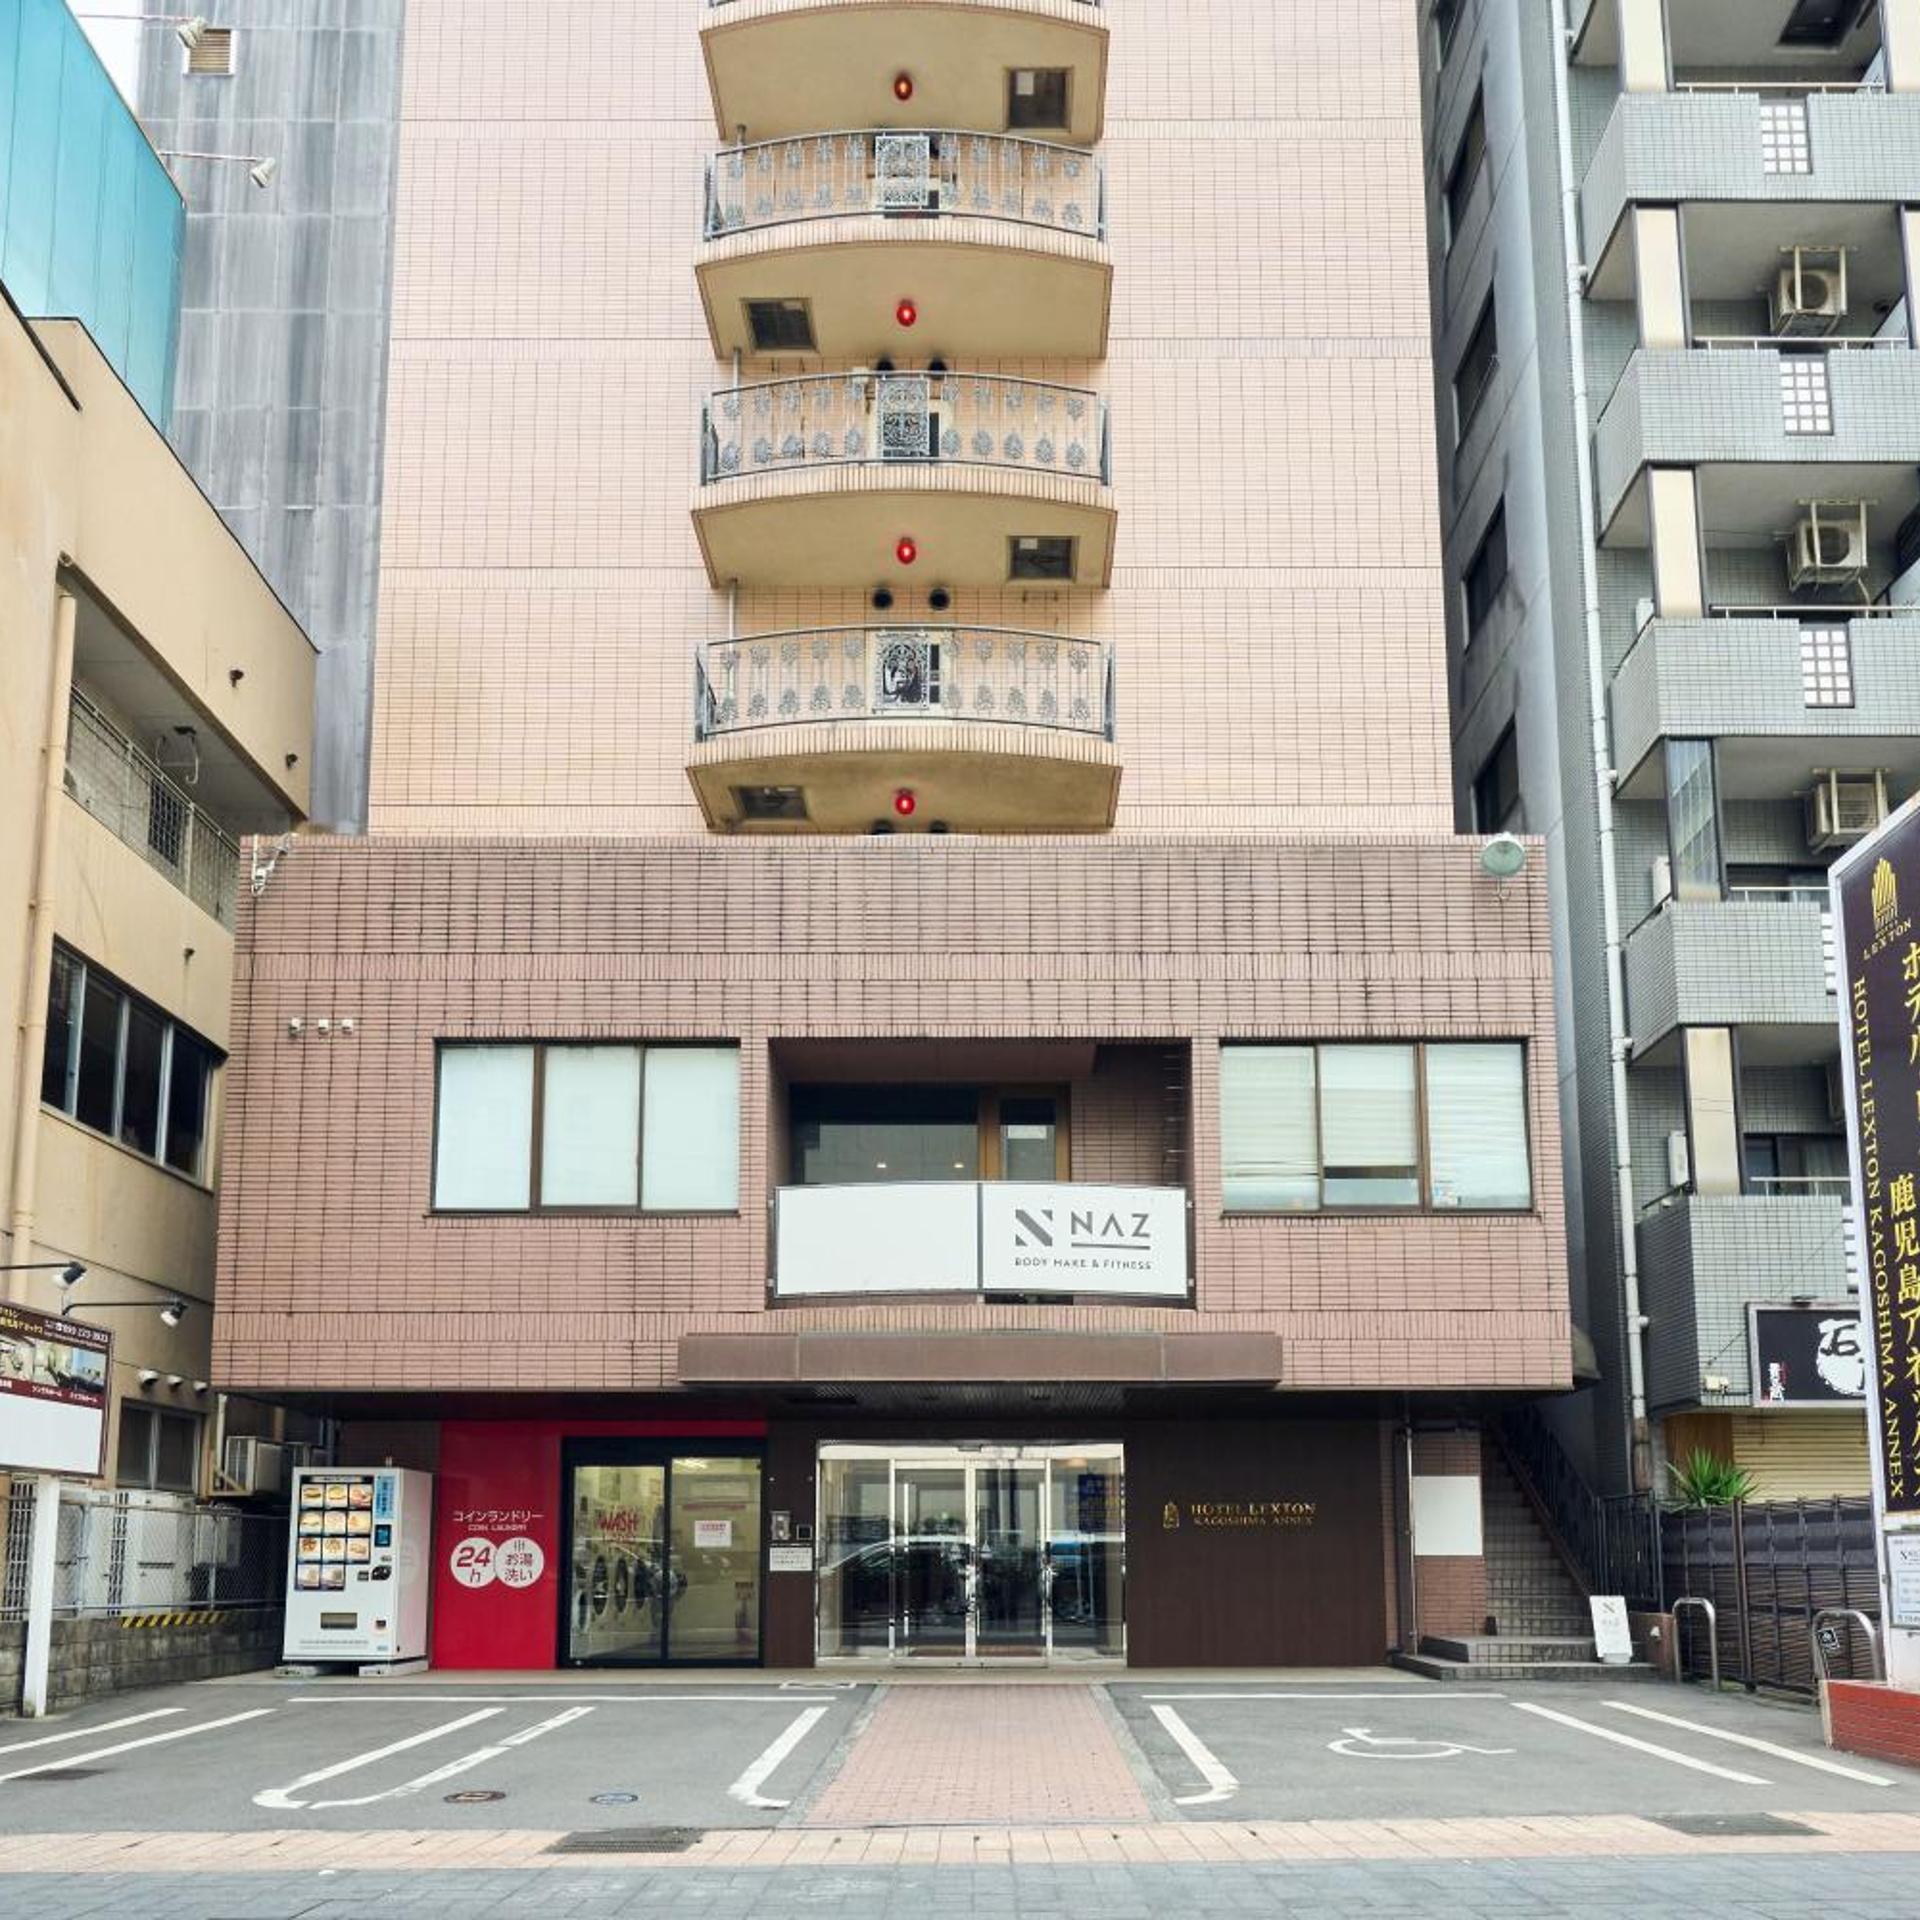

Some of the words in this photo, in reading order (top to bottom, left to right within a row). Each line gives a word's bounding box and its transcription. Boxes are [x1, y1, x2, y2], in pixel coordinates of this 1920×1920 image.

[1863, 917, 1911, 960] LEXTON
[1854, 976, 1871, 1076] HOTEL
[1861, 1080, 1881, 1199] LEXTON
[1071, 1211, 1151, 1238] NAZ
[1015, 1257, 1048, 1267] BODY
[1053, 1259, 1087, 1268] MAKE
[1103, 1259, 1152, 1270] FITNESS
[1870, 1205, 1896, 1387] KAGOSHIMA
[1885, 1398, 1904, 1498] ANNEX
[453, 1509, 545, 1523] コインランドリー
[456, 1546, 491, 1567] 24
